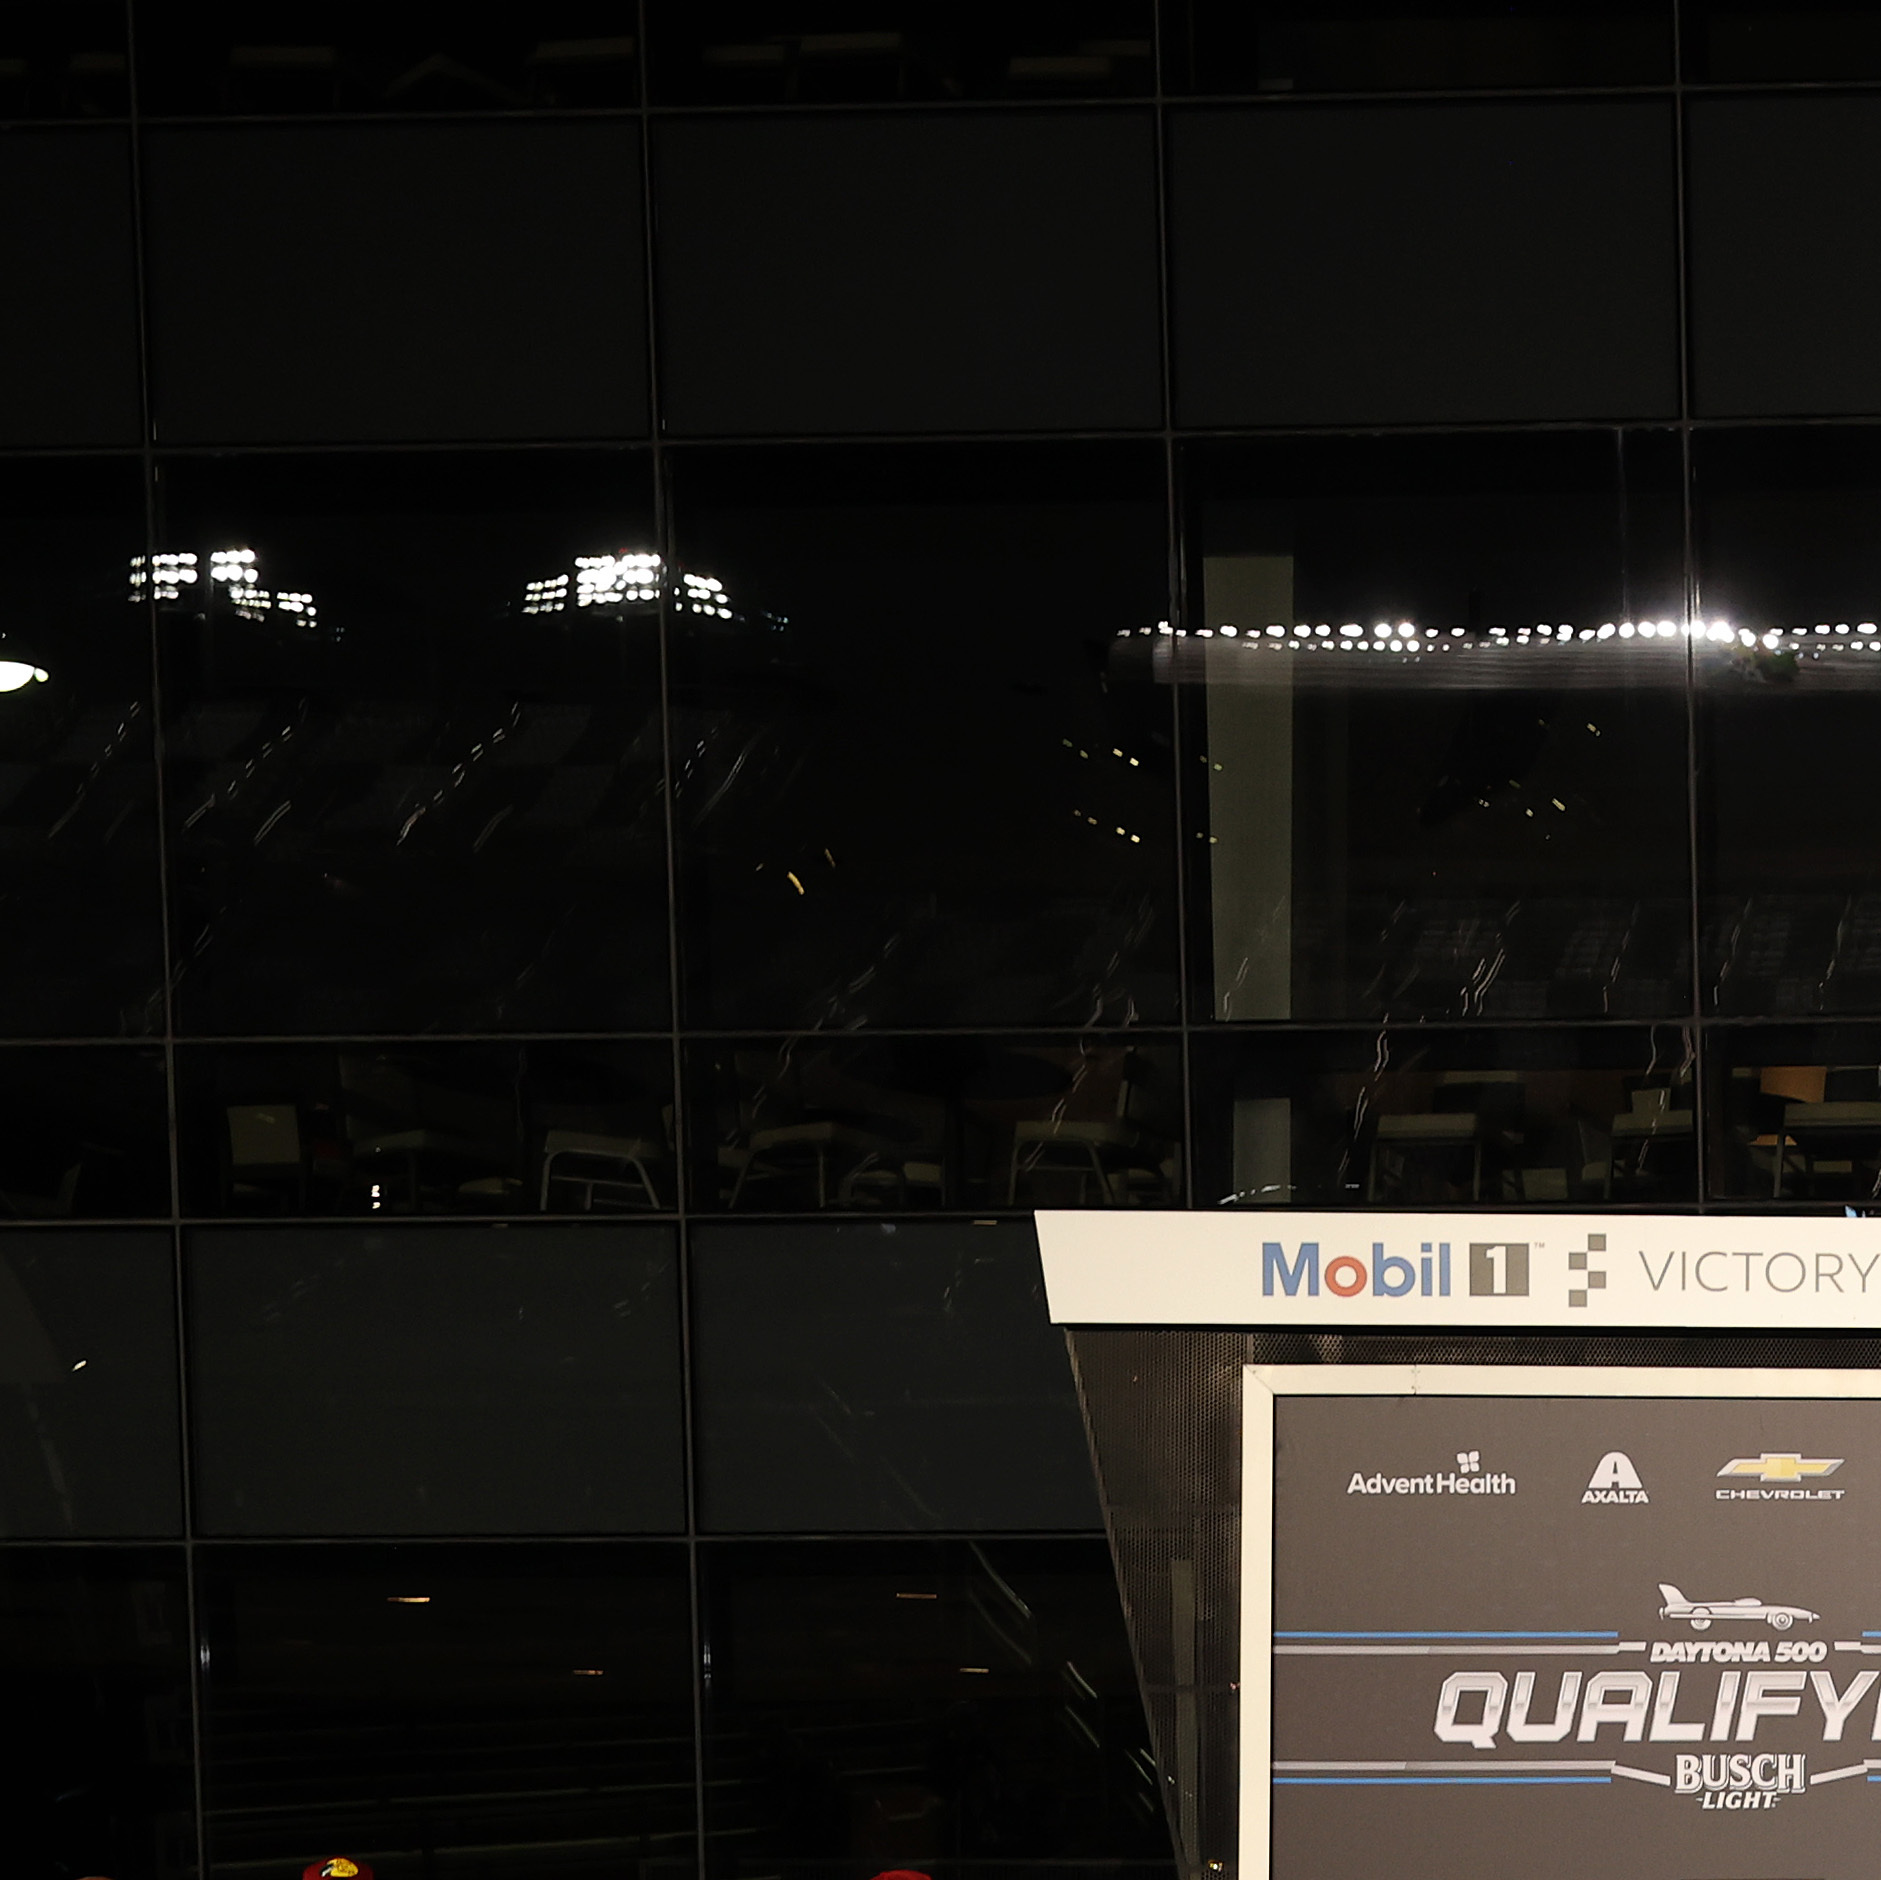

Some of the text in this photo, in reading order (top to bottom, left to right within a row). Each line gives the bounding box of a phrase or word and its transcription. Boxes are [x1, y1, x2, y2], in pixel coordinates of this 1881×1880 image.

[1262, 1242, 1450, 1298] Mobil
[1639, 1251, 1881, 1297] VICTORY
[1347, 1473, 1516, 1497] AdventHealth
[1716, 1489, 1844, 1500] CHEVROLET
[1582, 1489, 1649, 1505] AXALTA
[1650, 1642, 1827, 1662] DAYTONA 500
[1675, 1754, 1805, 1795] BUSCH
[1703, 1791, 1777, 1808] LIGHT
